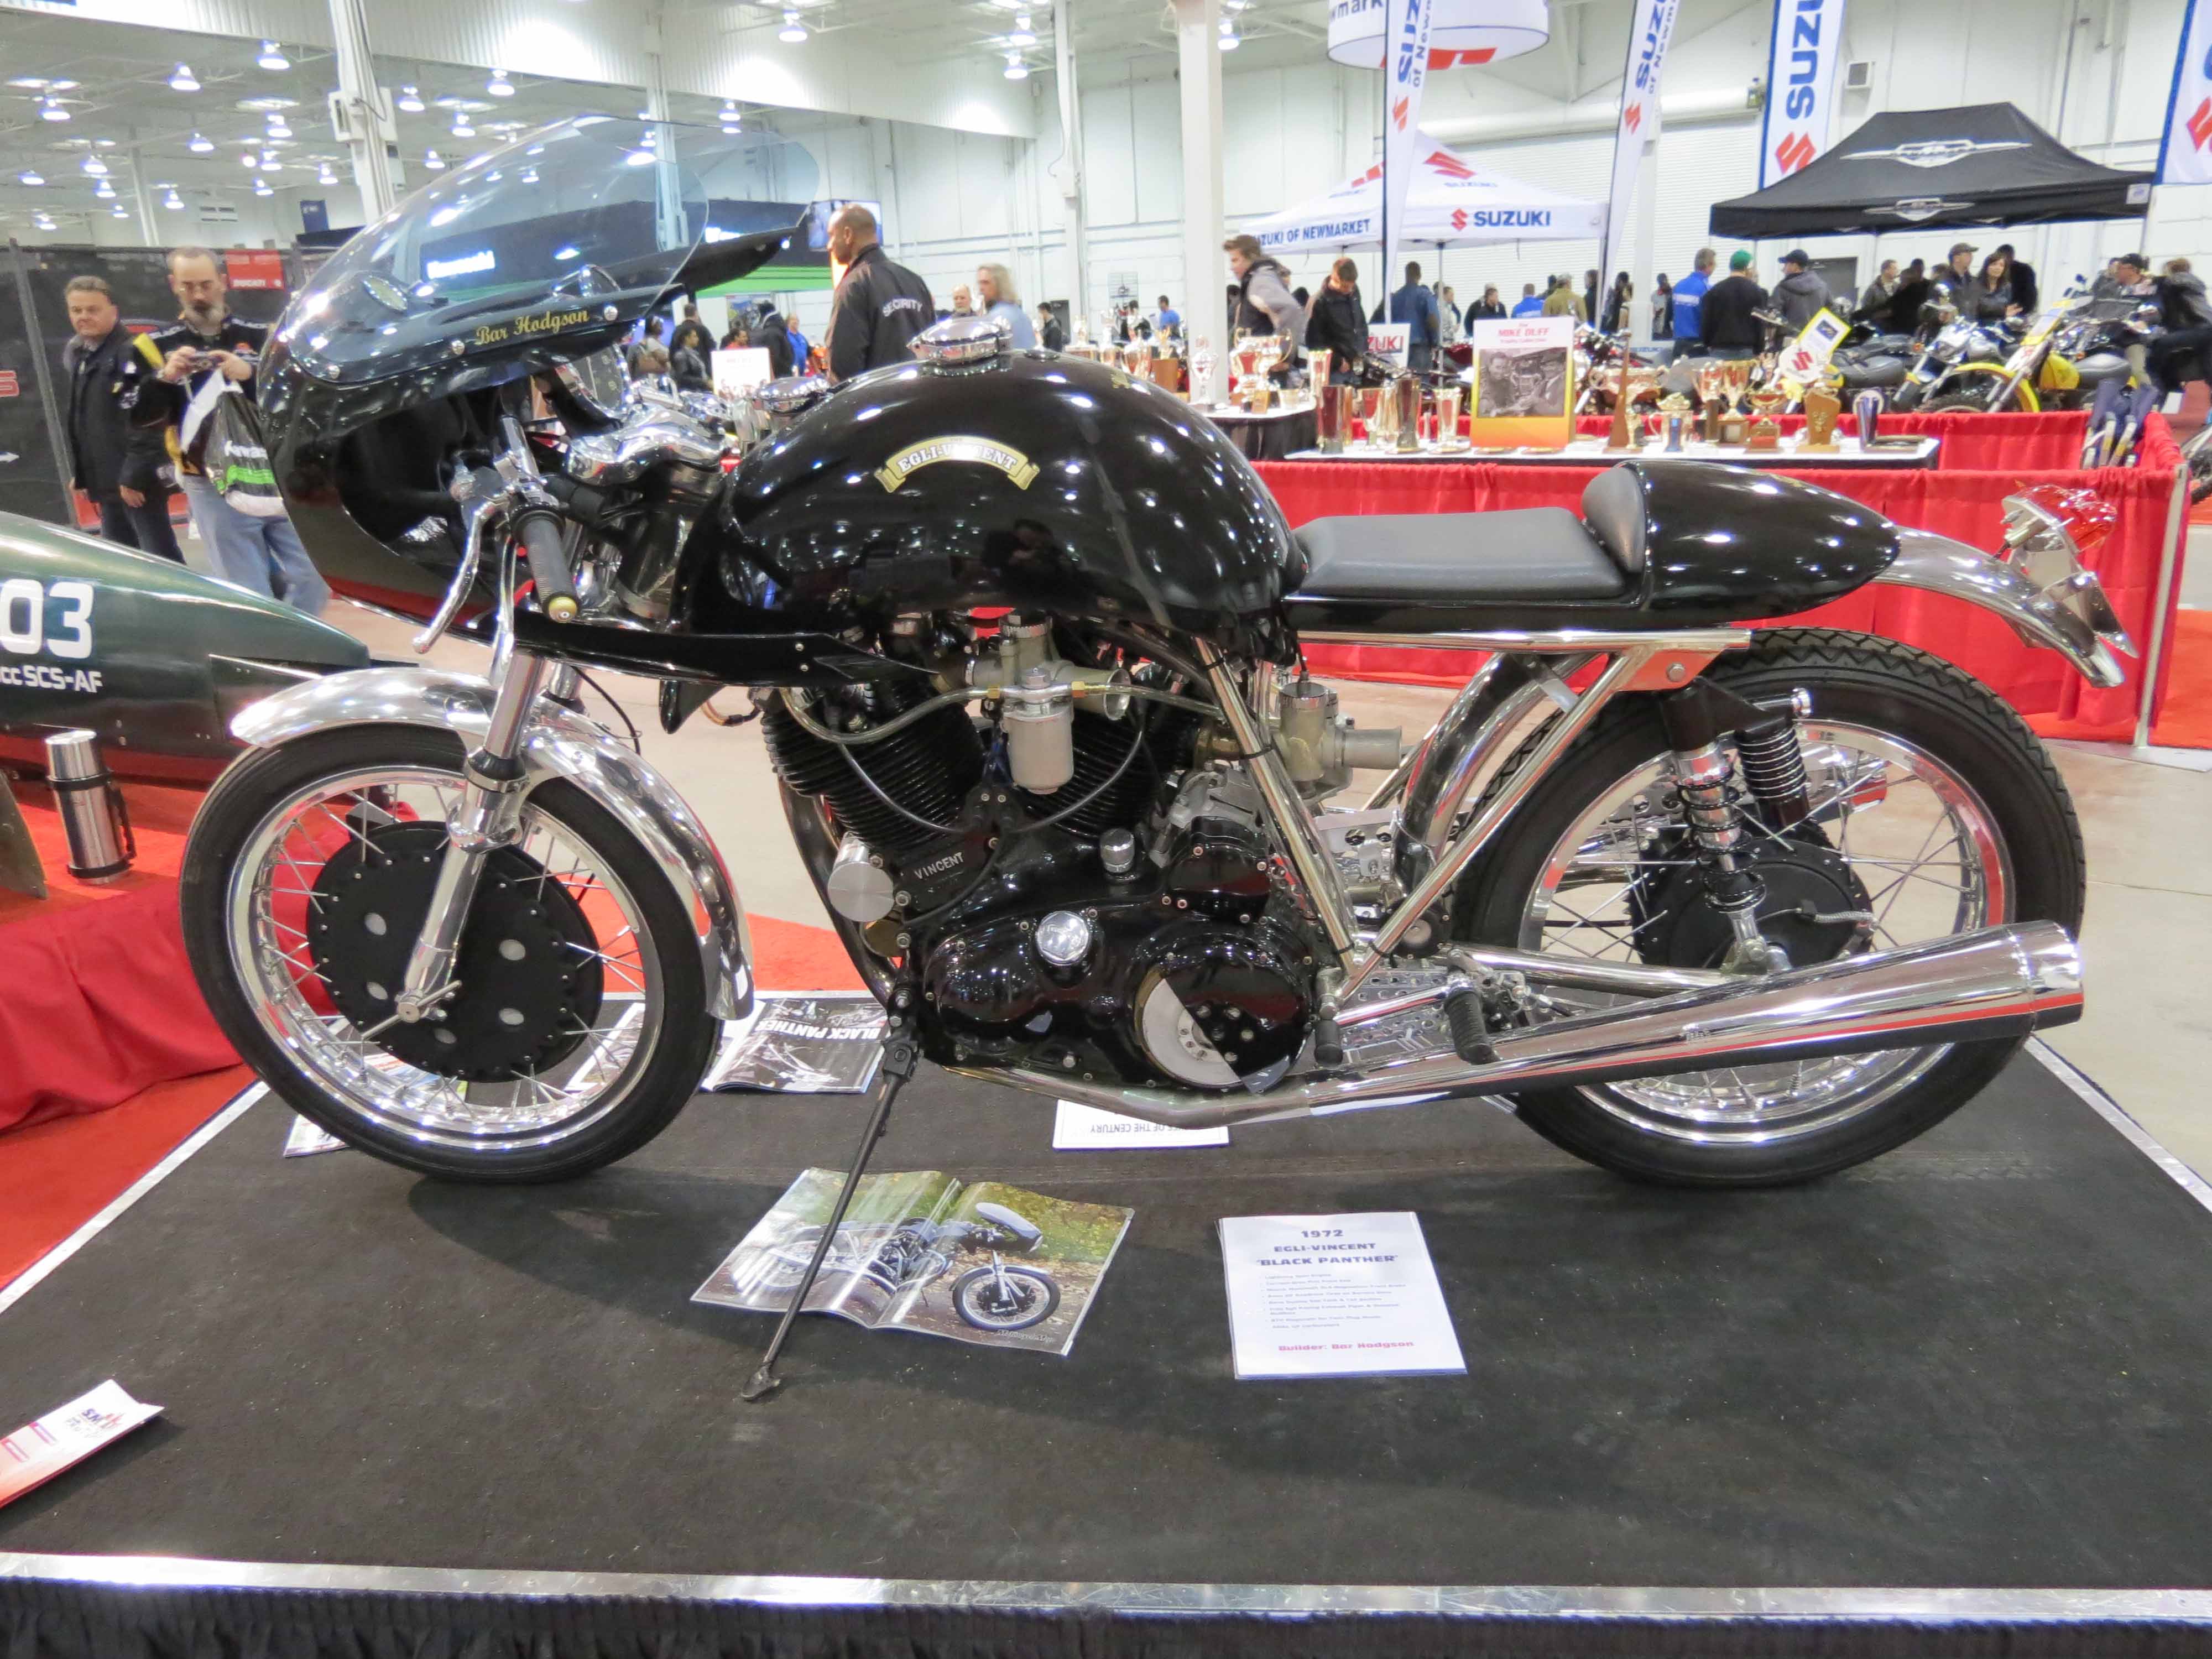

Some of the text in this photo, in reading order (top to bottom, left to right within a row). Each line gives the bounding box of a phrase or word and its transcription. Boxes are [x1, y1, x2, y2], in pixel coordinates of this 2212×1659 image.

[1474, 210, 1551, 227] SUZUKI
[1287, 229, 1300, 242] OF
[1303, 218, 1370, 239] NEWMARKET
[474, 310, 590, 345] Bar Hodgson
[914, 852, 963, 879] VINCENT
[755, 1020, 881, 1040] BLACK PANTHER
[1091, 1124, 1131, 1133] CENTURY
[1134, 1124, 1150, 1133] THE
[1301, 1229, 1344, 1238] 1972
[1274, 1243, 1376, 1252] EGLI-VINCENT
[1358, 1341, 1415, 1349] Hodgson
